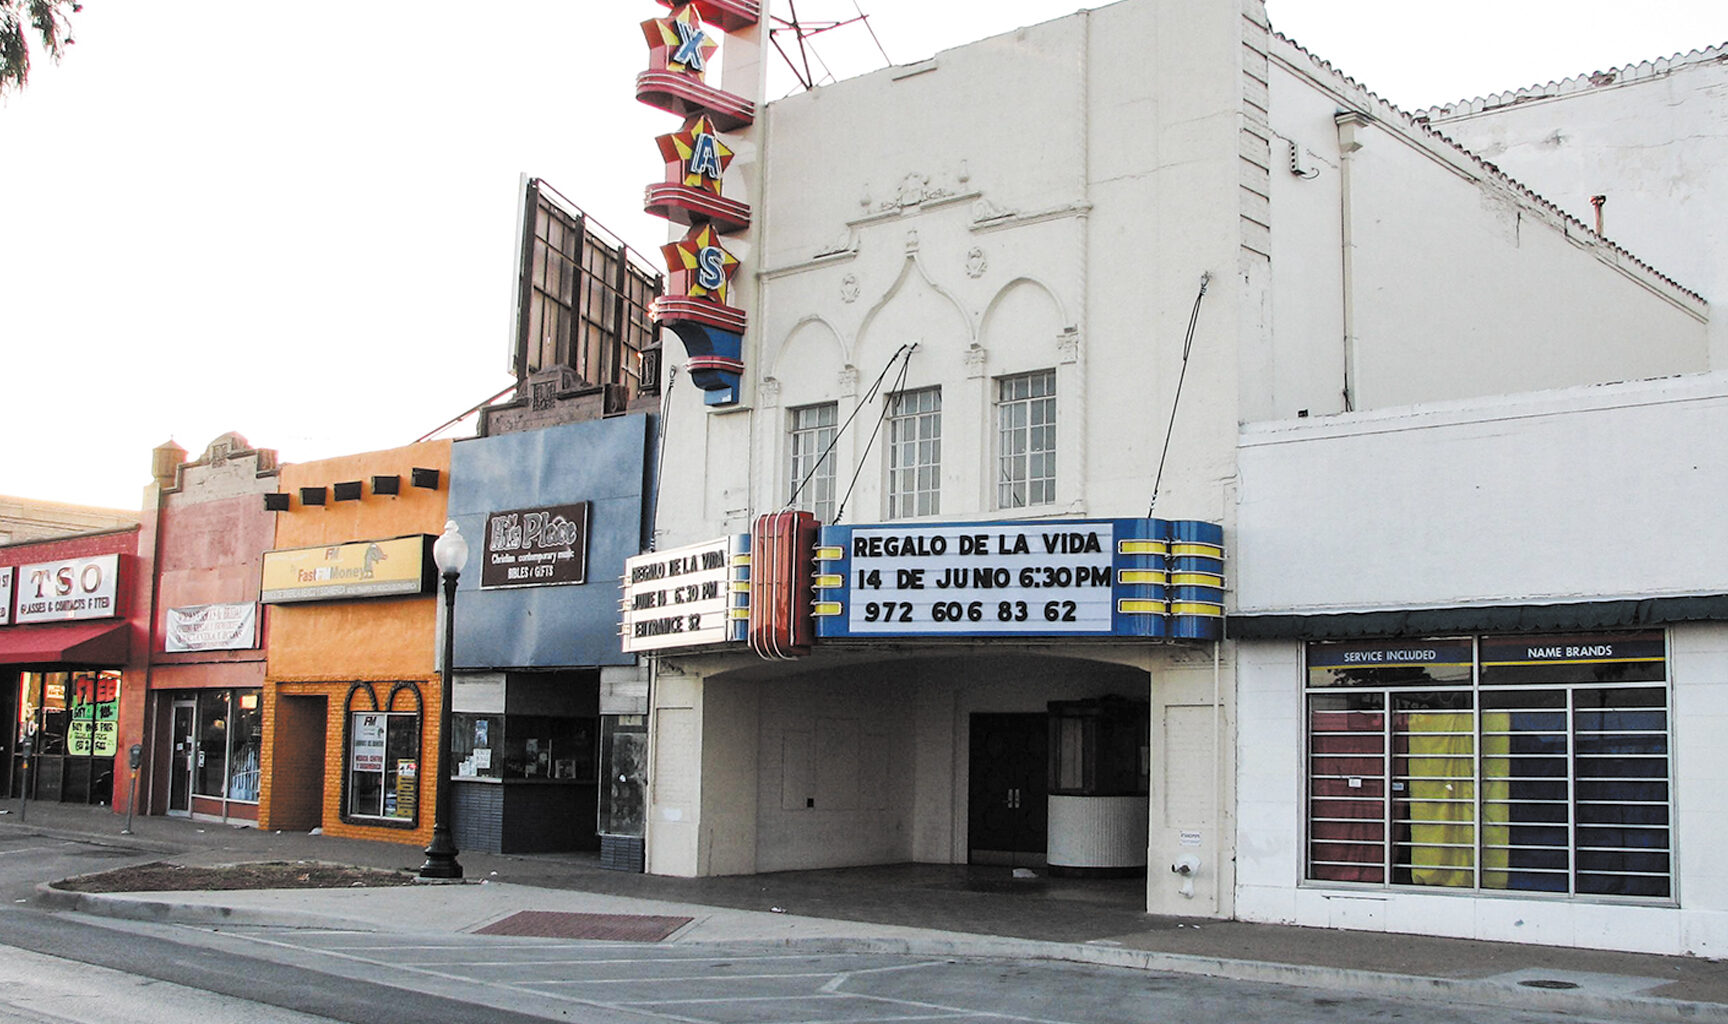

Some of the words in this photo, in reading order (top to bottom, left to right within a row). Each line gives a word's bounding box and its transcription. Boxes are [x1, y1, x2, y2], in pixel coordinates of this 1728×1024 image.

[490, 513, 522, 551] His
[521, 511, 577, 549] Place
[853, 536, 948, 557] REGALO
[959, 535, 989, 556] DE
[999, 534, 1030, 555] LA
[1042, 532, 1102, 554] VIDA
[518, 551, 557, 564] contemporary
[632, 562, 666, 584] REGALO
[669, 558, 682, 577] DE
[682, 555, 698, 575] LA
[702, 550, 725, 571] VIDA
[30, 564, 103, 598] TSO
[297, 568, 317, 583] Fast
[534, 565, 554, 578] GIFTS
[858, 569, 882, 590] 14
[897, 569, 925, 589] DE
[1019, 566, 1072, 588] 6:30
[20, 602, 46, 615] GASSES
[88, 596, 111, 609] FTTED
[633, 592, 656, 611] JUNE
[702, 581, 718, 600] PM
[865, 602, 913, 623] 972
[932, 602, 983, 622] 606
[997, 601, 1028, 622] 83
[1044, 601, 1077, 622] 62
[635, 615, 683, 638] ENTRANCE
[1344, 651, 1382, 662] SERVICE
[1386, 650, 1436, 661] INCLUDED
[1528, 647, 1561, 658] NAME
[1566, 645, 1612, 657] BRANDS
